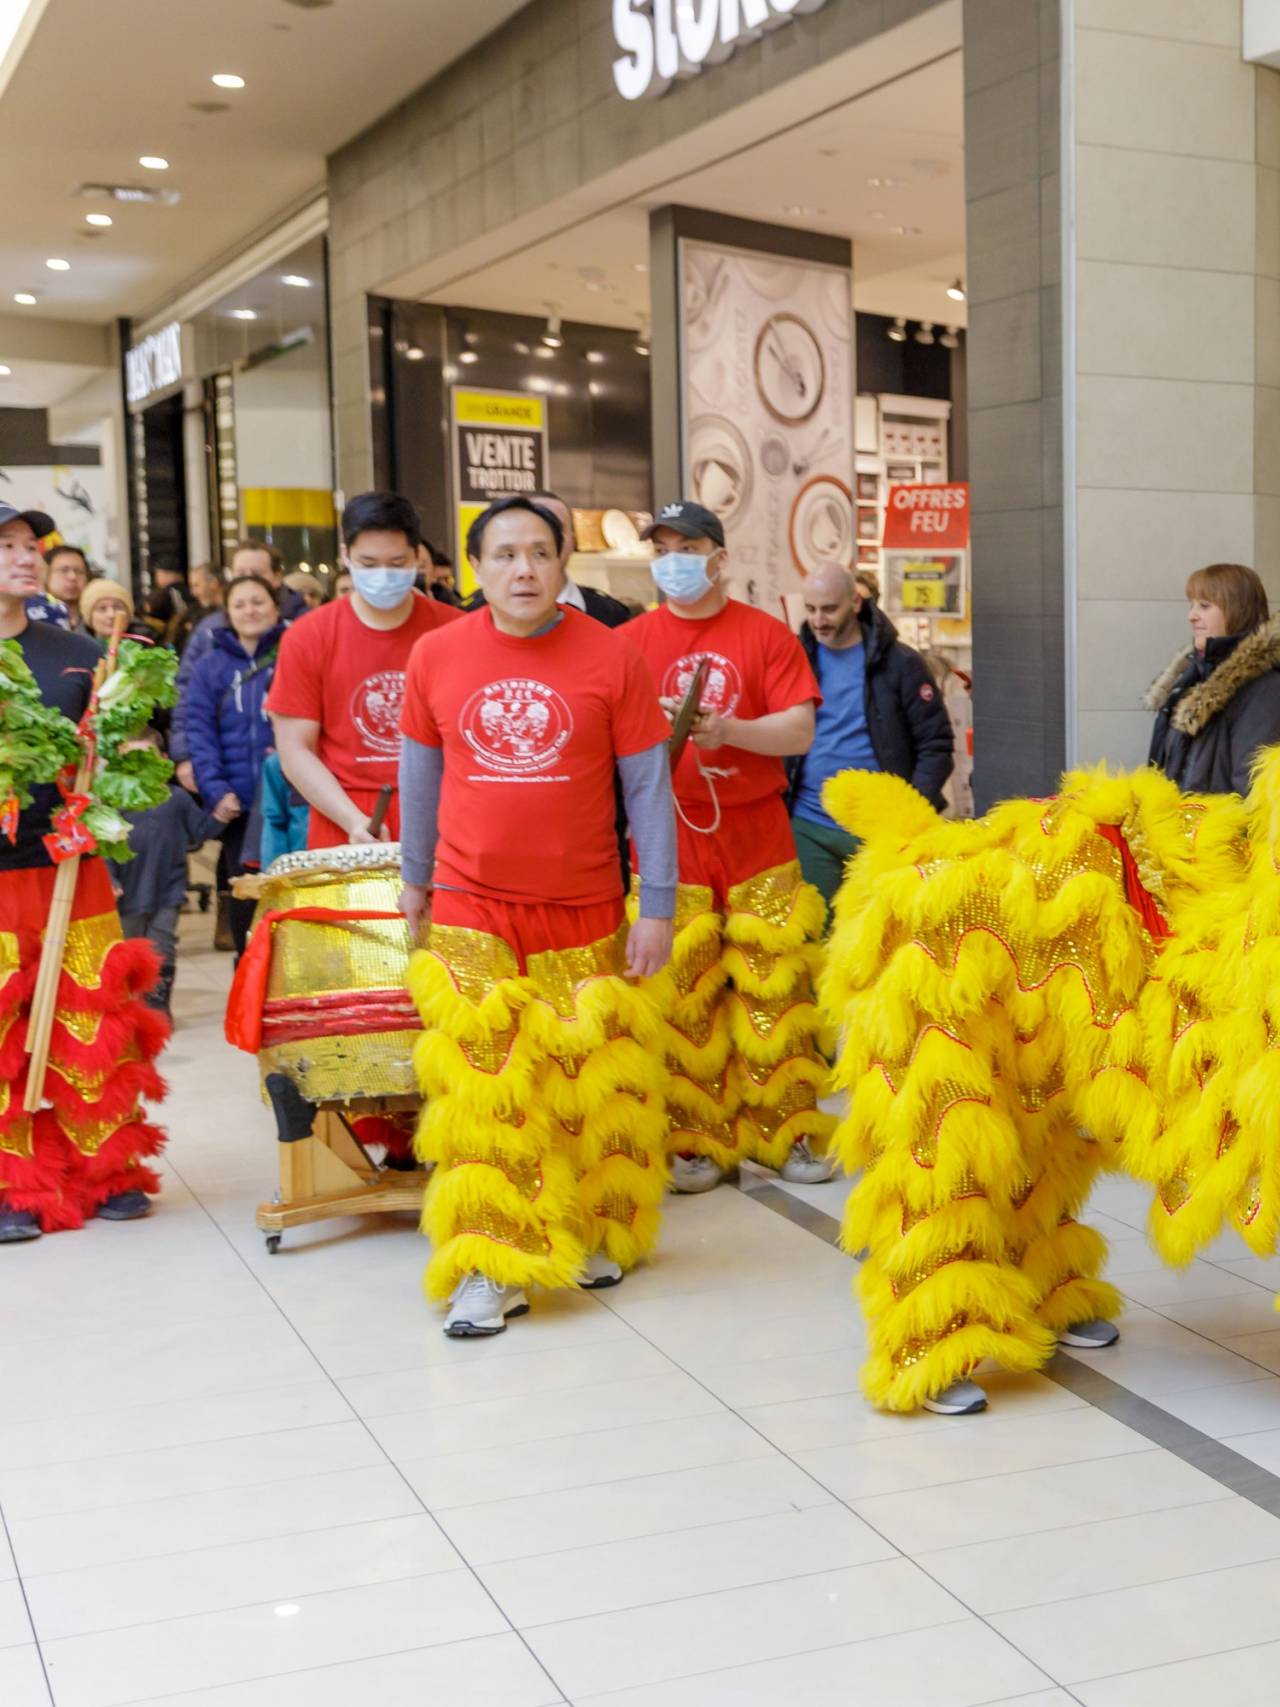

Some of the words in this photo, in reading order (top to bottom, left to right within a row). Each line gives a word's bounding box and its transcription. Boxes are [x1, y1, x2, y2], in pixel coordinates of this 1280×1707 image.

[465, 432, 536, 470] VENTE
[467, 466, 536, 492] TROTTOIR
[893, 488, 967, 511] OFFRES
[910, 511, 949, 533] FEU
